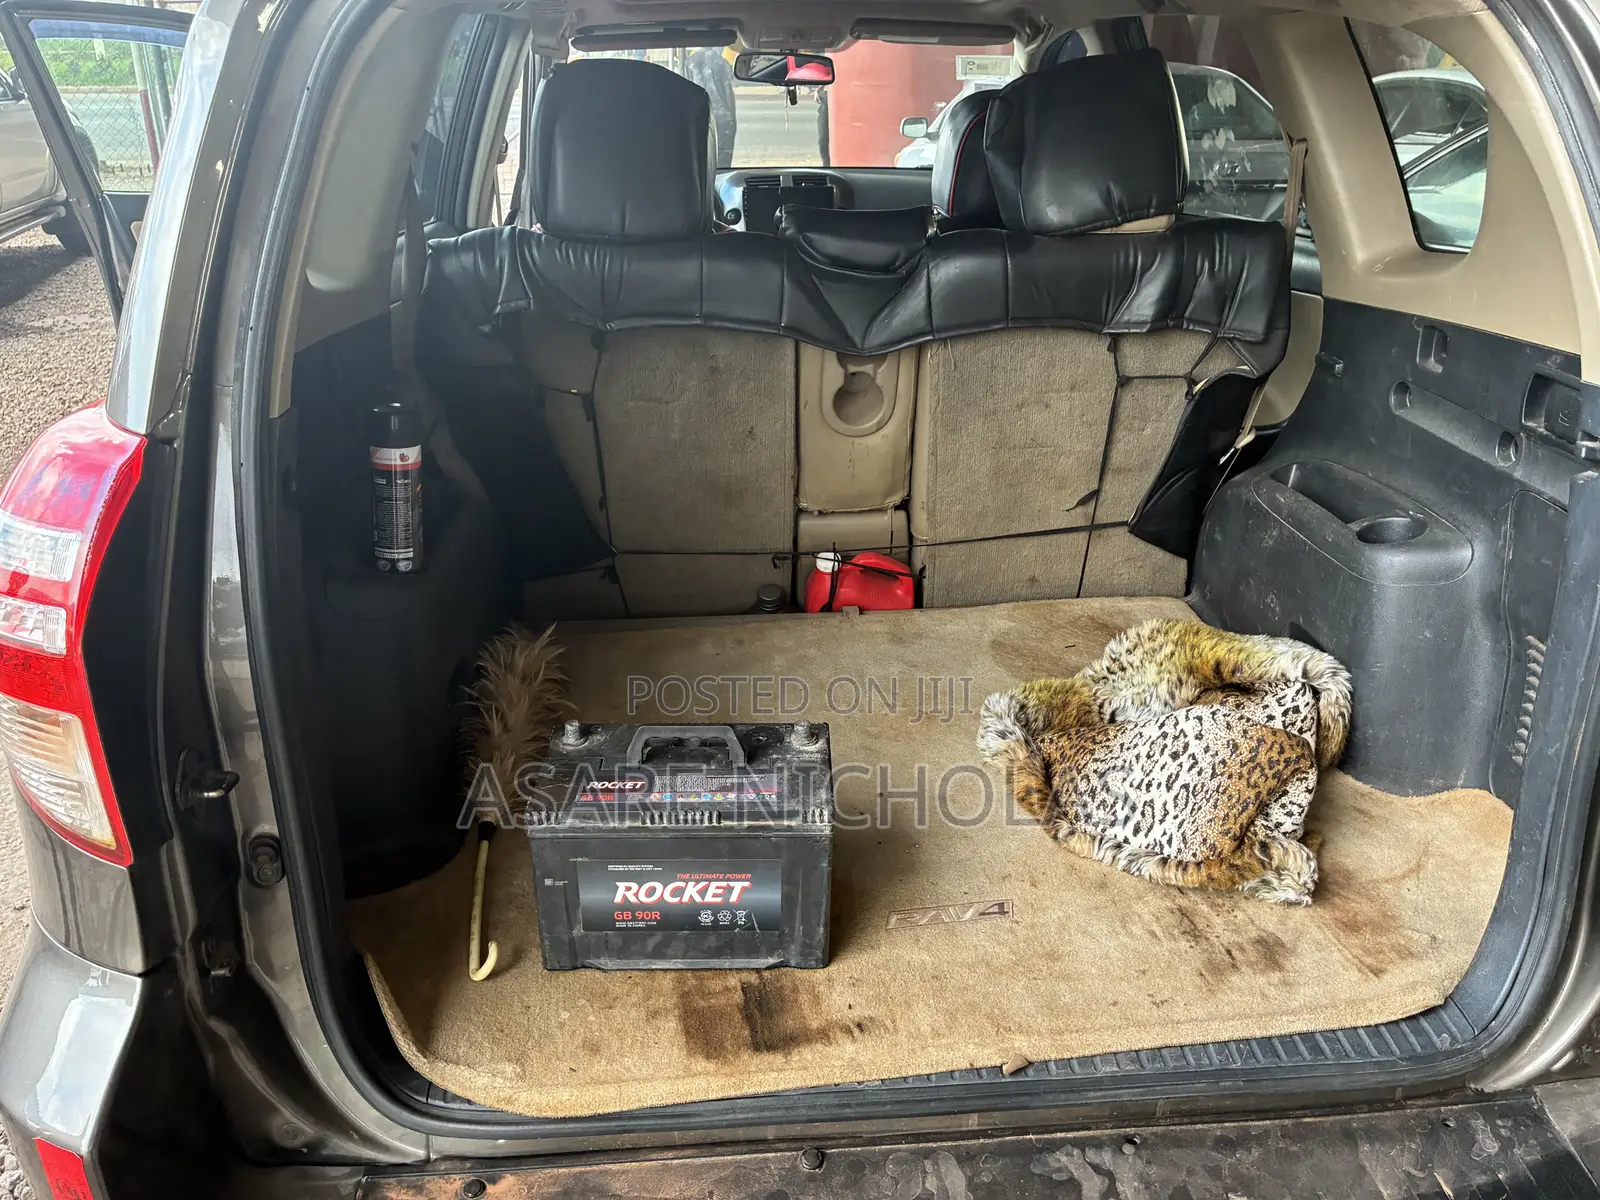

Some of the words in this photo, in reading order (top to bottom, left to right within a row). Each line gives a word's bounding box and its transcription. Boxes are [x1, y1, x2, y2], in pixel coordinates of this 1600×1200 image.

[586, 781, 646, 789] ROCKET
[613, 881, 752, 904] ROCKET
[614, 911, 632, 920] GB
[635, 911, 661, 920] 90R
